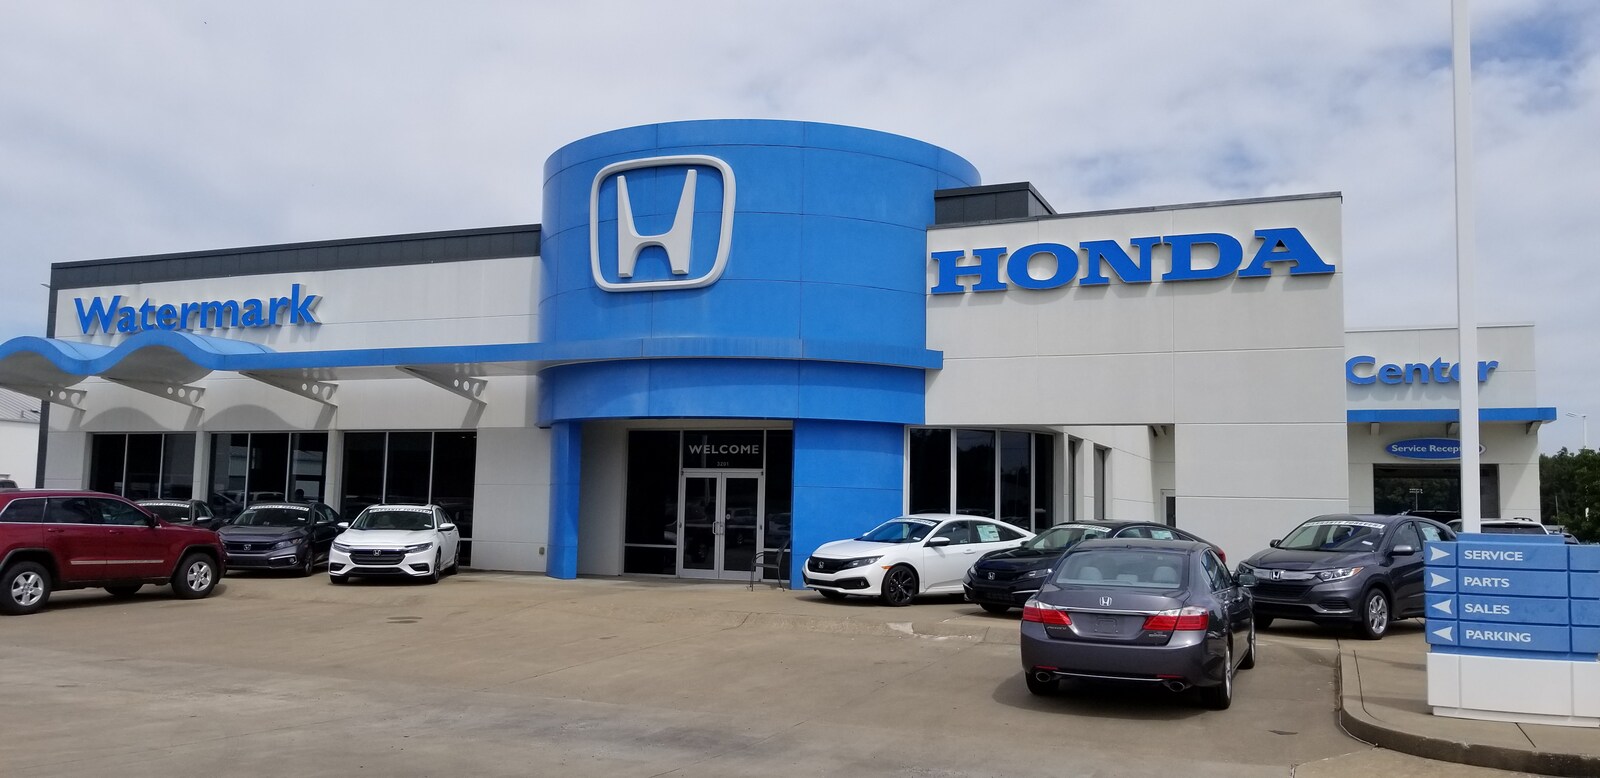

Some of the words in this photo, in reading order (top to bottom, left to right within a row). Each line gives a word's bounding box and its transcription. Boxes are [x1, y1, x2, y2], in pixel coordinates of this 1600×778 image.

[930, 227, 1336, 295] HONDA
[74, 283, 322, 335] Watermark
[688, 444, 760, 455] WELCOME
[1391, 444, 1427, 453] Service
[1464, 549, 1523, 562] SERVICE
[1464, 576, 1510, 588] PARTS
[1464, 603, 1511, 615] SALES
[1465, 629, 1532, 643] PARKING
